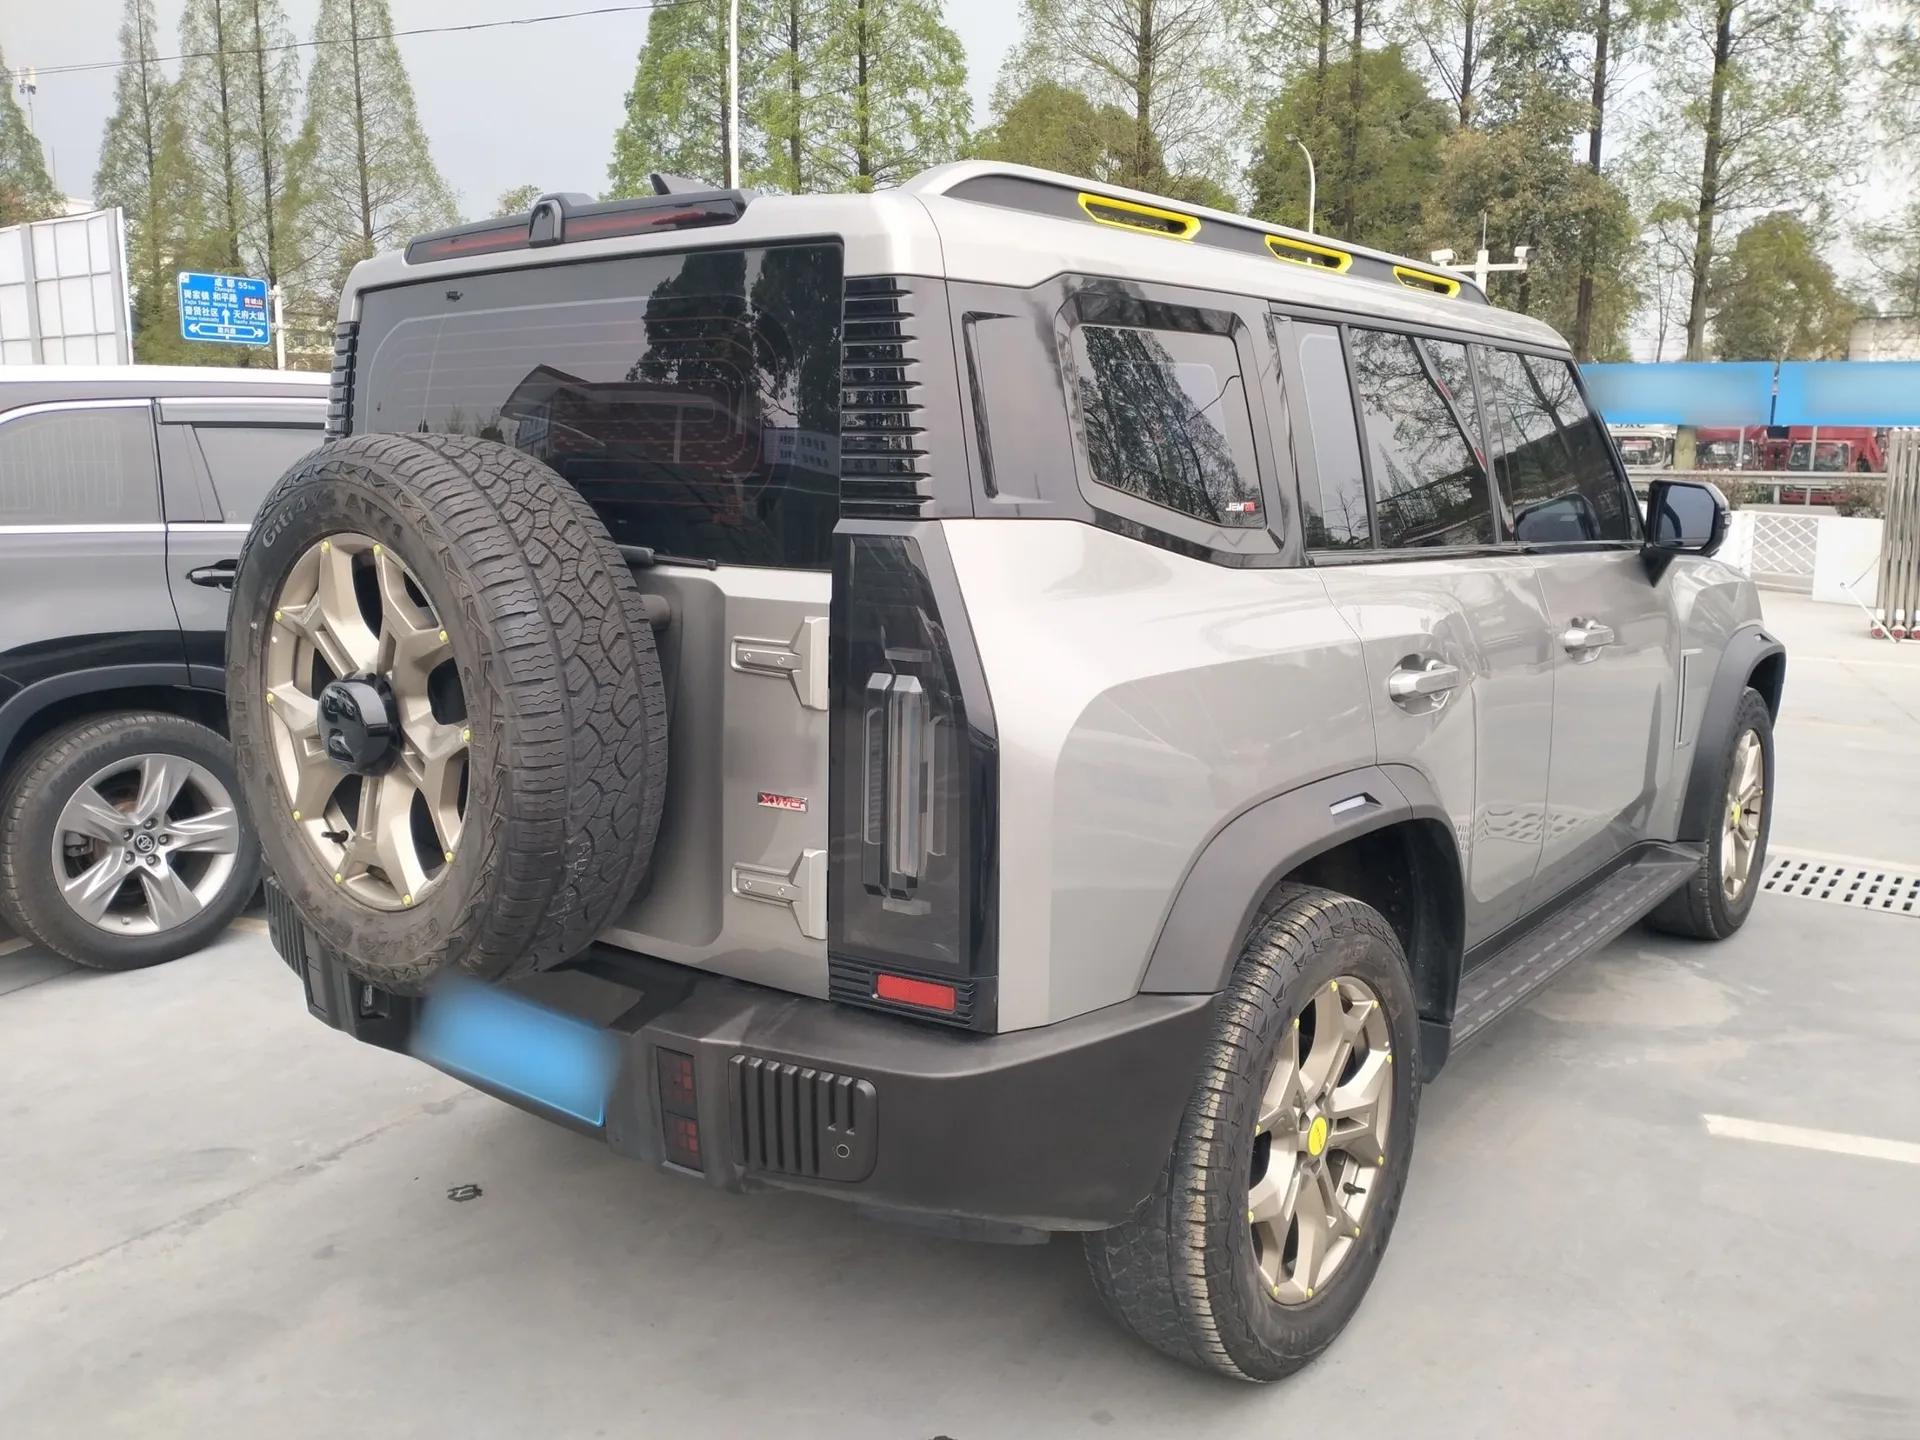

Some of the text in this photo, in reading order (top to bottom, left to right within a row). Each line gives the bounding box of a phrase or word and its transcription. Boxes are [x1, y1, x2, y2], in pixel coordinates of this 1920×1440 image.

[213, 292, 238, 303] 和平路
[233, 309, 265, 321] 天府大道
[263, 506, 293, 547] Giti
